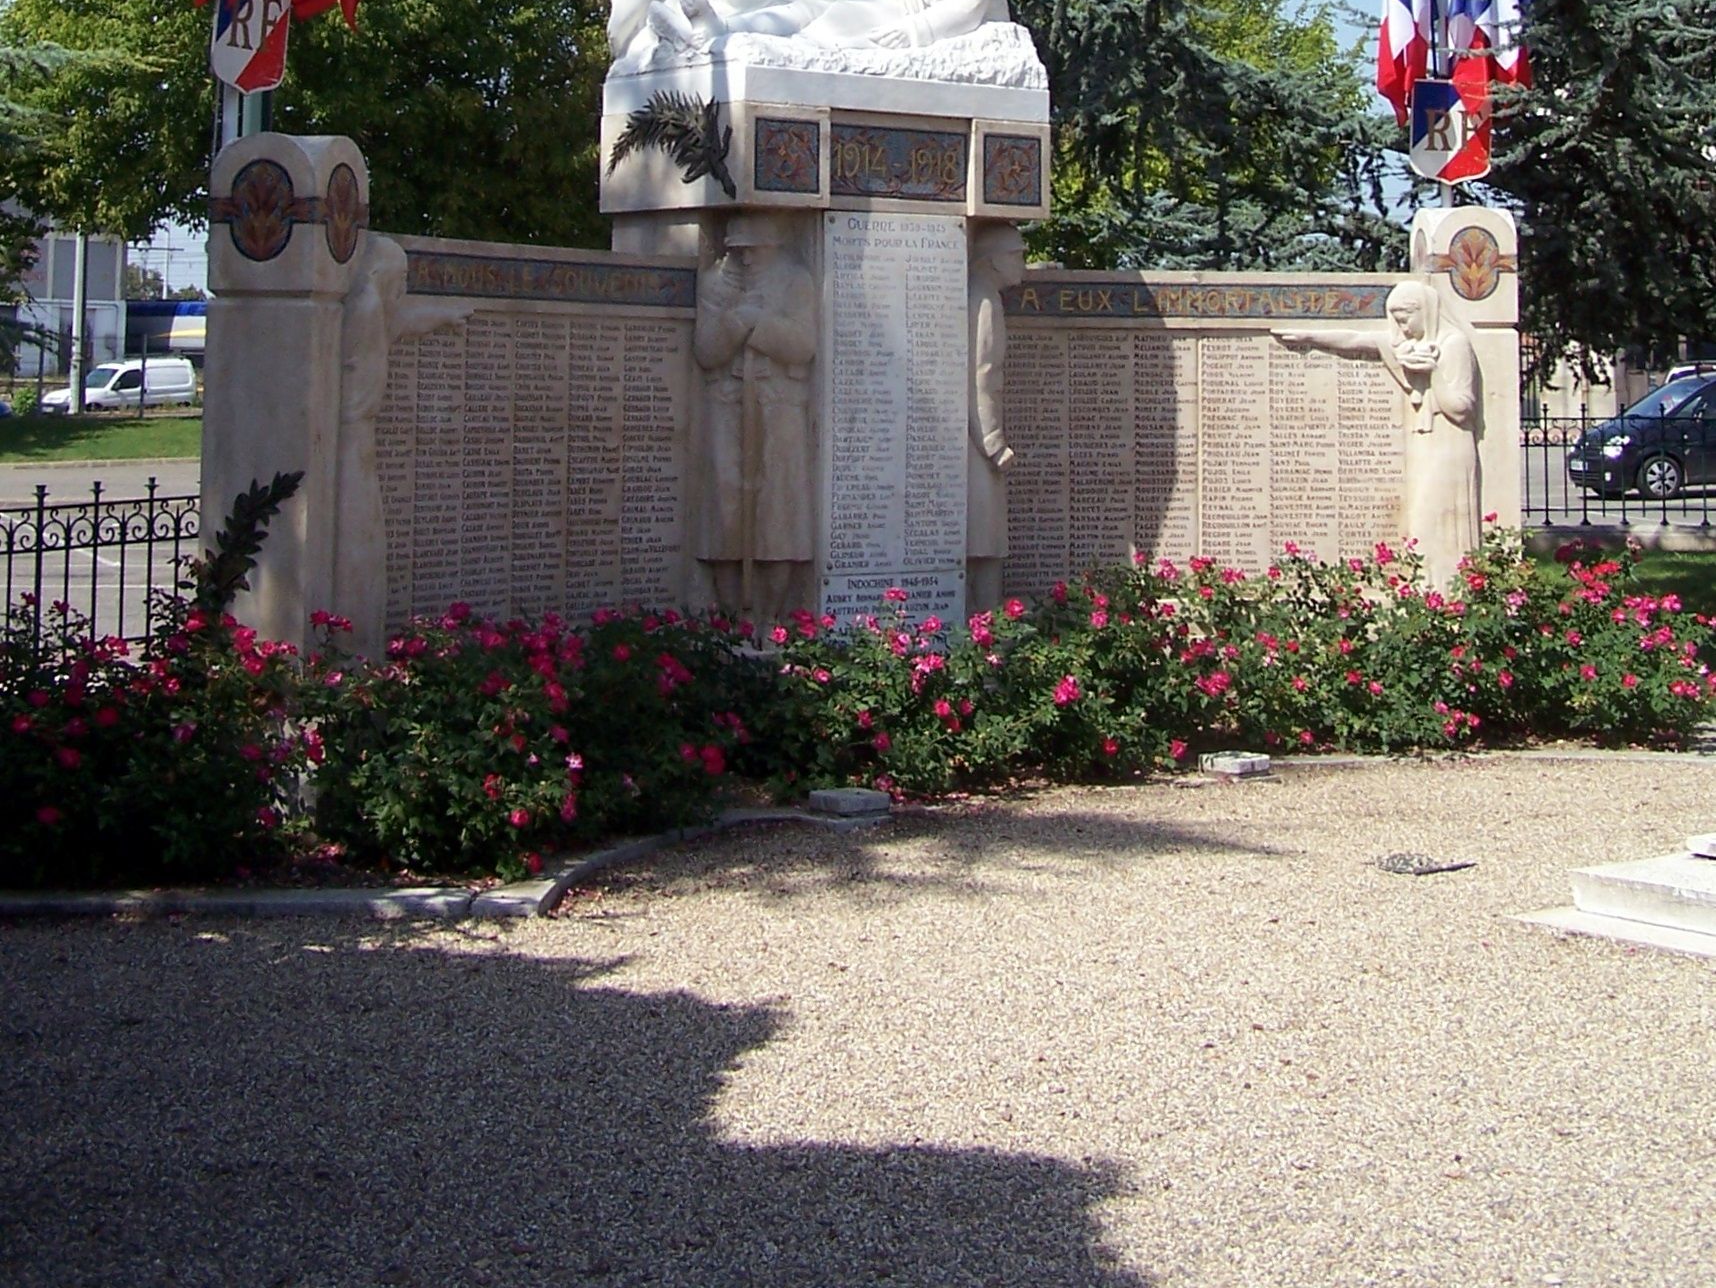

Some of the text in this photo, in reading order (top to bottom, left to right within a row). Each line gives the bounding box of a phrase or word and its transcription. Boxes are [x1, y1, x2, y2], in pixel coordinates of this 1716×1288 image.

[1424, 108, 1483, 152] RF
[833, 142, 887, 178] 1914
[911, 149, 957, 184] 1918
[832, 235, 959, 250] MORTS POUR LA FRANCE
[1020, 288, 1041, 311] A
[1060, 290, 1113, 312] EUX
